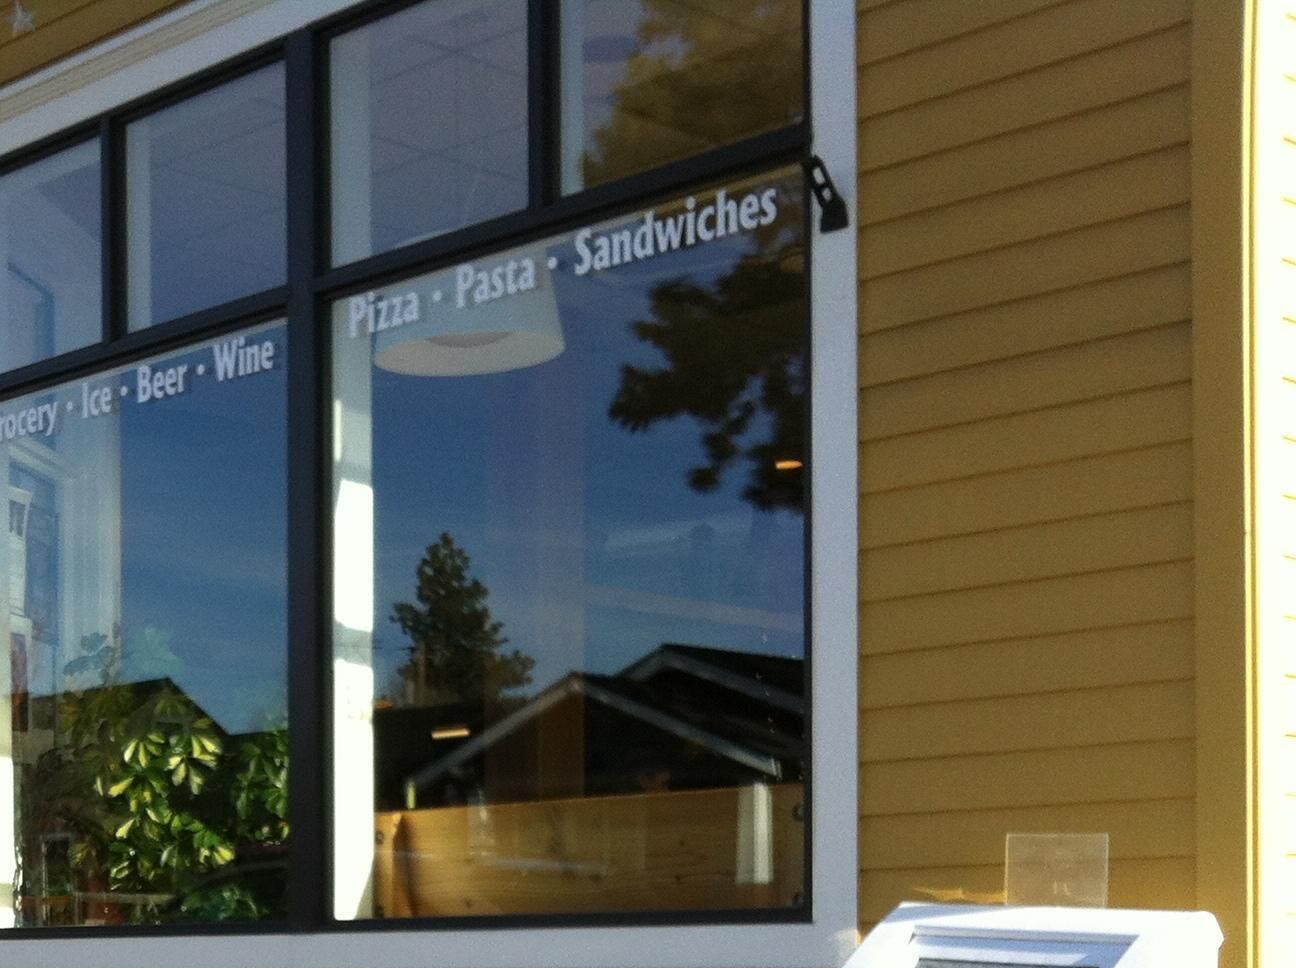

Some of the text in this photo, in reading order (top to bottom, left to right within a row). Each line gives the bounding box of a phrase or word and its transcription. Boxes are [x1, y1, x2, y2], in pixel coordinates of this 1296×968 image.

[348, 187, 778, 338] Pizza Pasta Sandwiches
[81, 382, 112, 419] Ice
[136, 364, 188, 404] Beer
[213, 336, 275, 382] Wine
